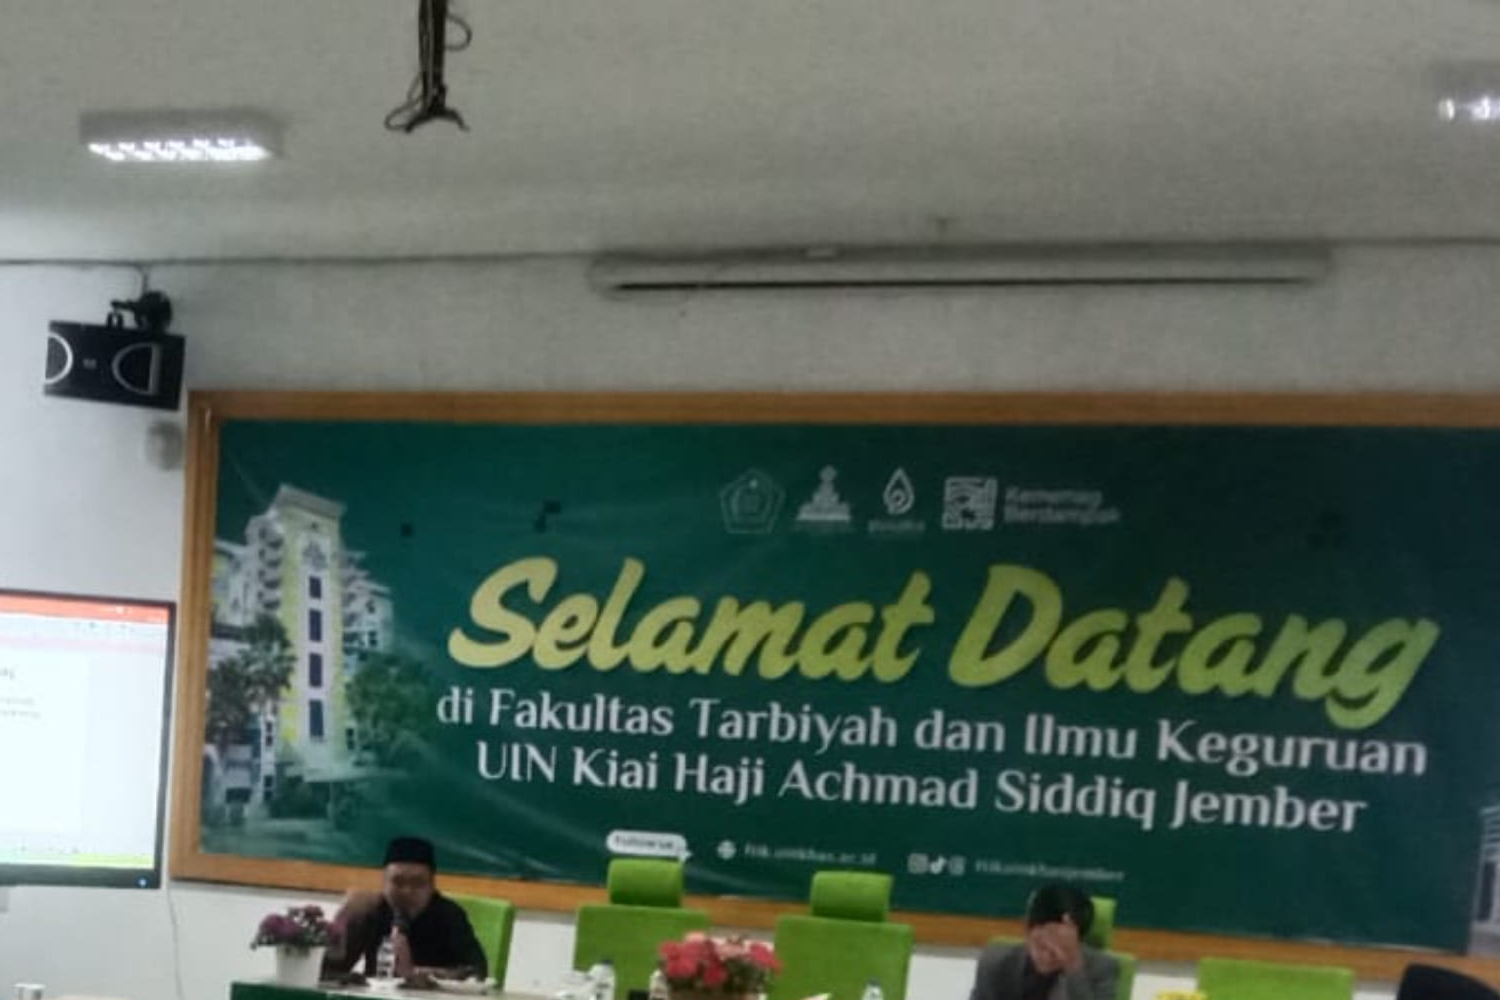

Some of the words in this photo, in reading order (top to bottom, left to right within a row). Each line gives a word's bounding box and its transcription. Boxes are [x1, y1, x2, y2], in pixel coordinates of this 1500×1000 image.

[447, 556, 935, 683] Selamat
[947, 564, 1441, 730] Datang
[436, 687, 474, 725] di
[489, 689, 675, 736] Fakultas
[688, 698, 898, 754] Tarbiyah
[913, 709, 1004, 752] dan
[1024, 713, 1137, 760] Ilmu
[1156, 719, 1428, 776] Keguruan
[476, 740, 556, 783] UIN
[572, 747, 658, 790] Kiai
[674, 753, 764, 802] Haji
[778, 760, 978, 809] Achmad
[994, 769, 1157, 831] Siddiq
[1169, 780, 1368, 833] Jember
